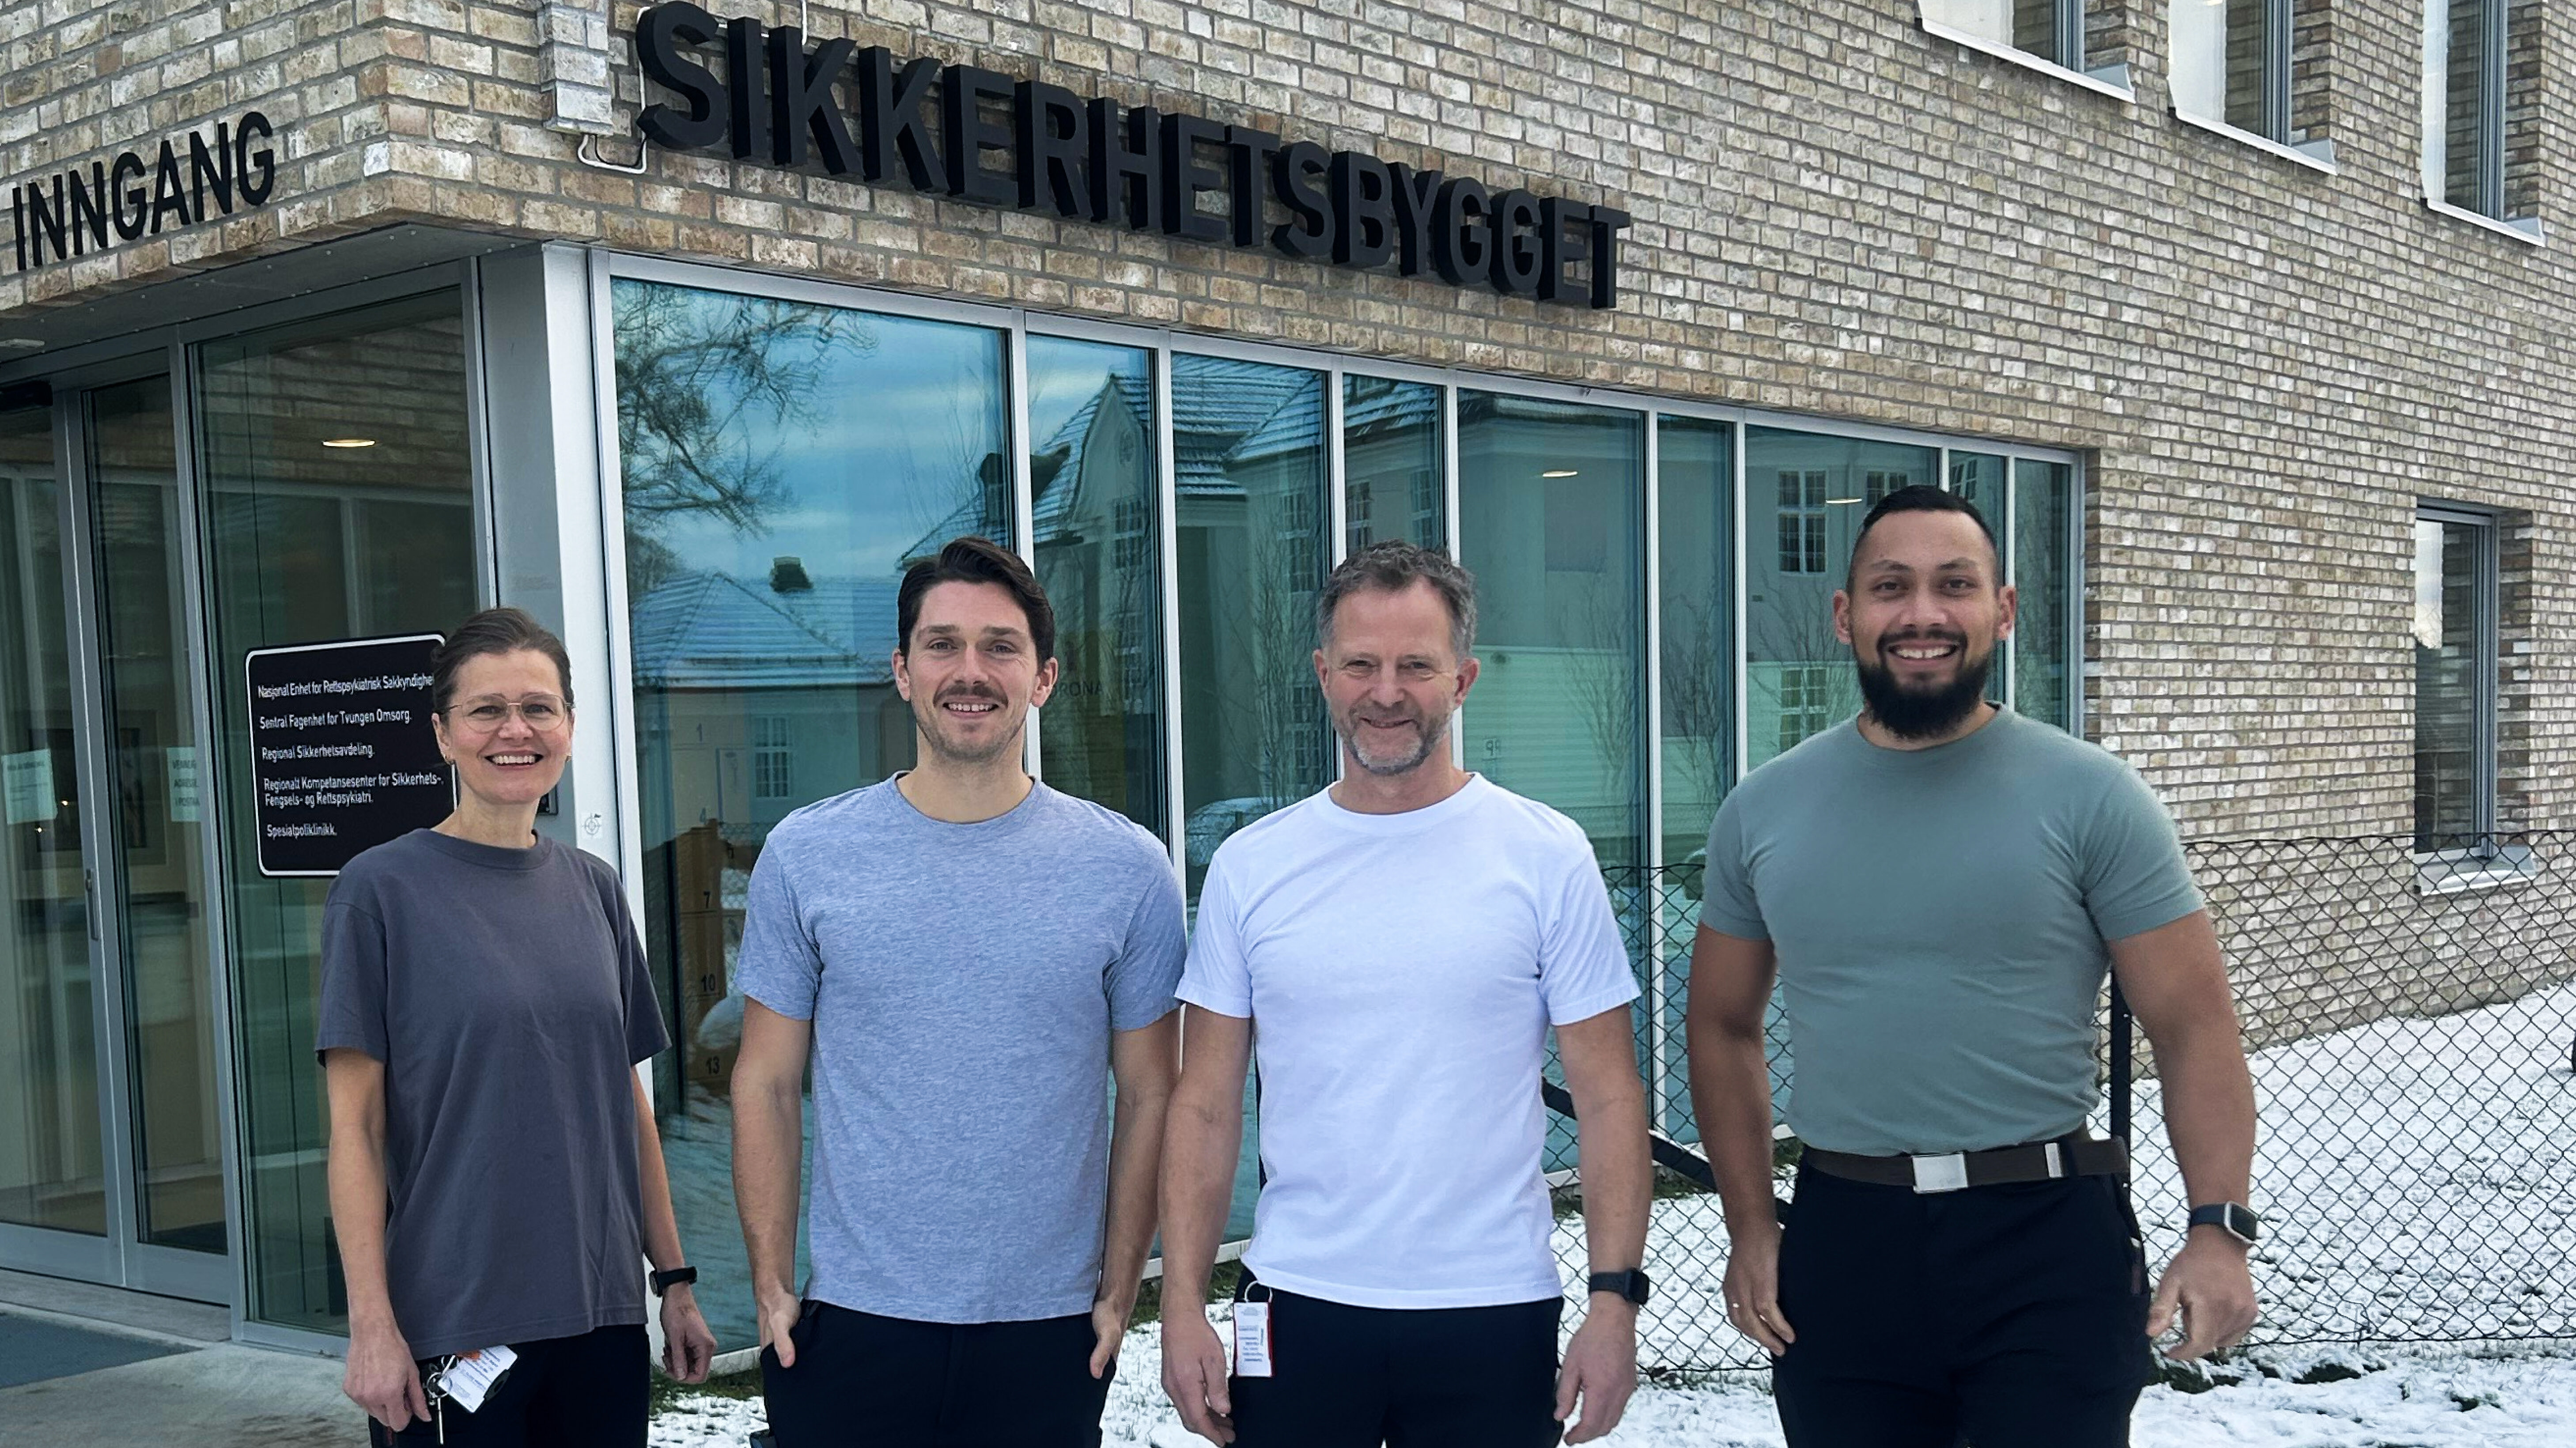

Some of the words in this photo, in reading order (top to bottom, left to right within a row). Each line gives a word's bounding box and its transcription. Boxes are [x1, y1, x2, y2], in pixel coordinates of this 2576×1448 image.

[635, 0, 1630, 309] SIKKERHETSBYGGET
[12, 111, 275, 271] INNGANG
[258, 683, 289, 701] Nasjonal
[290, 682, 311, 696] Enhet
[312, 681, 322, 694] for
[323, 676, 382, 695] Rettspsykiatrisk
[260, 715, 287, 730] Sentral
[289, 713, 325, 730] Fagenhet
[327, 711, 339, 725] for
[339, 711, 375, 726] Tvungen
[377, 708, 412, 724] Omsorg.
[262, 745, 295, 763] Regional
[297, 742, 374, 758] Sikkerhetsavdeling.
[264, 776, 300, 794] Regionalt
[301, 775, 377, 792] Kompetansesenter
[378, 773, 391, 787] for
[265, 793, 303, 809] Fengsels-
[305, 795, 315, 809] og
[317, 790, 374, 807] Rettspsykiatri.
[267, 823, 338, 840] Spesialpoliklinikk.
[703, 890, 711, 909] 7
[700, 974, 716, 992] 10
[706, 1057, 720, 1075] 13
